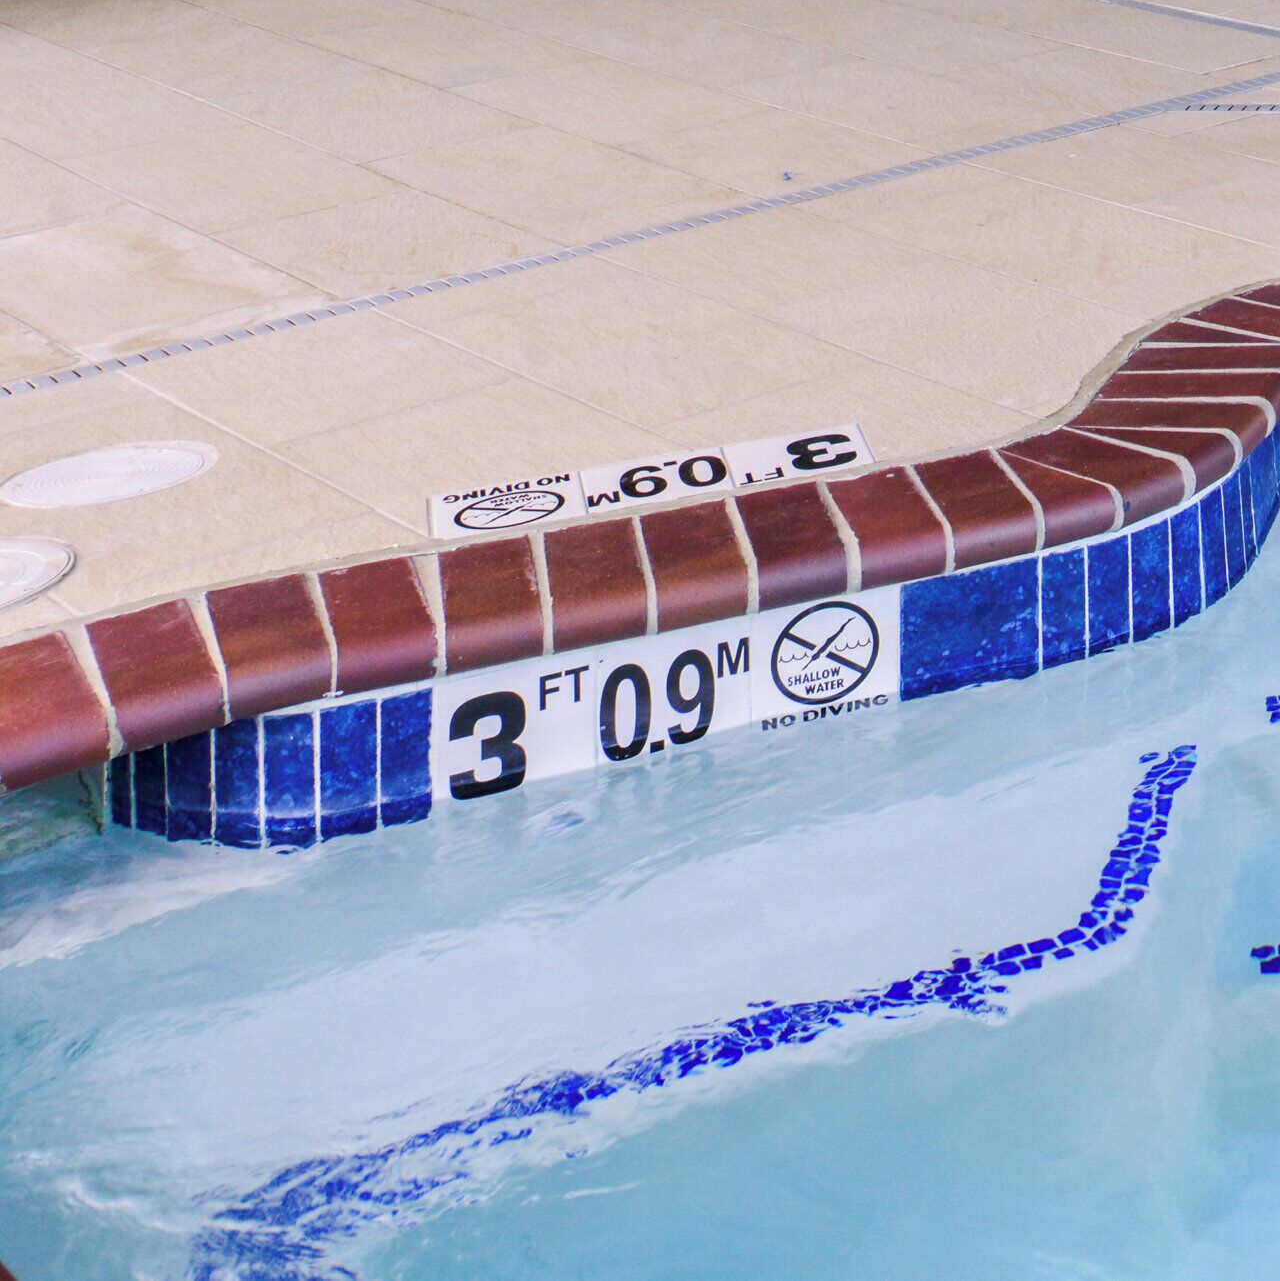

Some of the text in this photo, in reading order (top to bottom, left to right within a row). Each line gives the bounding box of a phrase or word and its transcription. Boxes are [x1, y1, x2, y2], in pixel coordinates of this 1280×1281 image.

[740, 433, 858, 485] 3 FT
[443, 473, 570, 504] NO DIVING
[490, 493, 529, 504] WATER
[788, 666, 841, 687] SHALLOW
[805, 678, 845, 695] WATER
[761, 694, 889, 731] NO DIVING
[449, 665, 589, 800] 3 FT
